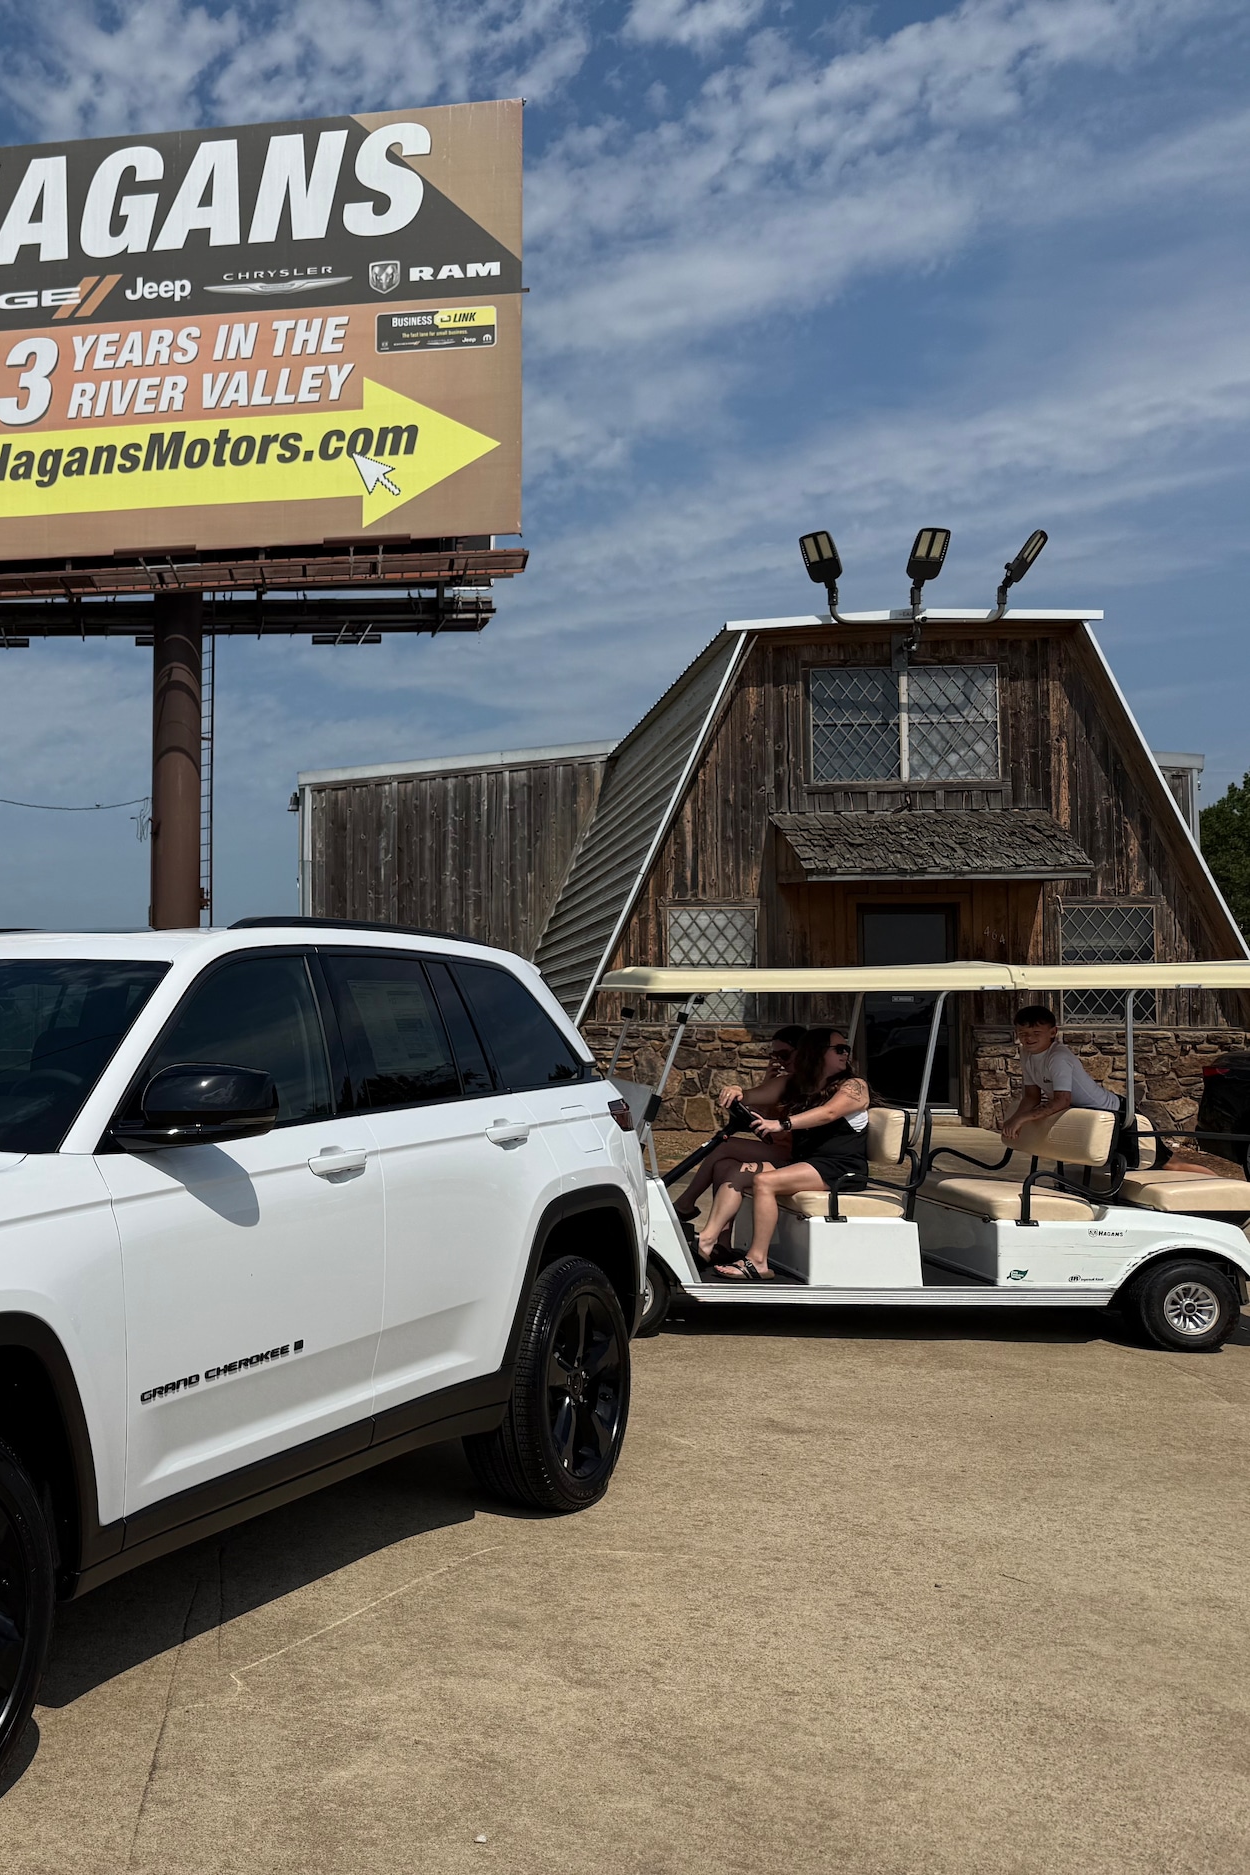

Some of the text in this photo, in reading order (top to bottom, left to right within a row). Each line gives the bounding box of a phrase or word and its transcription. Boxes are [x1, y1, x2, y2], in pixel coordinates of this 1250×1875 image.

[222, 265, 333, 281] CHRYSLER
[408, 261, 501, 282] RAM
[125, 277, 192, 302] Jeep
[391, 312, 477, 328] BUSINESS LINK
[72, 315, 350, 372] YEARS IN THE
[461, 336, 477, 344] Jeep
[67, 363, 356, 419] RIVER VALLEY
[983, 925, 1006, 945] 464
[139, 1343, 290, 1402] GRAND CHEROKEE
